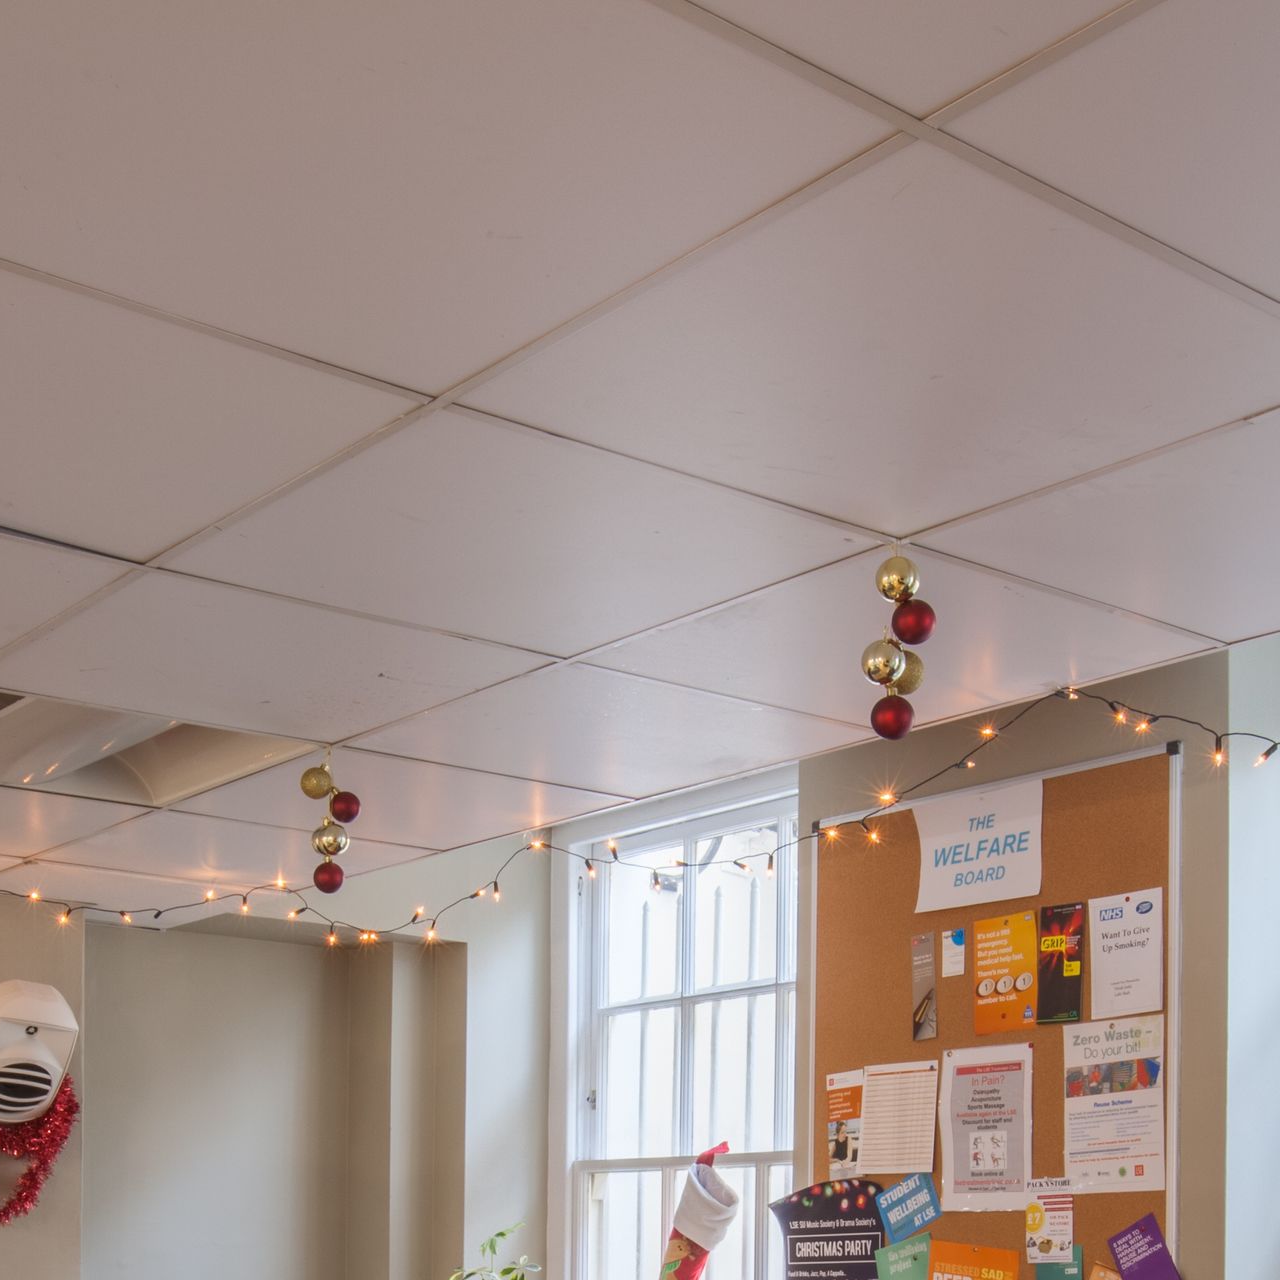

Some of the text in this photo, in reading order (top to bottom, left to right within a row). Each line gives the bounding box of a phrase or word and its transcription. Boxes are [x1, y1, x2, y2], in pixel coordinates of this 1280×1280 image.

[969, 814, 996, 832] THE
[933, 831, 1031, 868] WELFARE
[953, 866, 1006, 887] BOARD
[1100, 908, 1123, 921] NHS
[1101, 926, 1151, 940] Want To Give
[1042, 937, 1065, 949] GRIP
[1102, 938, 1150, 954] Up Smoking?
[1072, 1035, 1100, 1047] Zero
[1104, 1028, 1142, 1041] Waste
[1084, 1041, 1141, 1059] Do your bit!
[971, 1074, 1005, 1087] In Pain?
[880, 1174, 920, 1208] STUDENT
[887, 1188, 931, 1224] WELLBEING
[807, 1220, 819, 1228] Music
[820, 1219, 835, 1230] Society
[840, 1219, 855, 1227] Drama
[913, 1206, 936, 1227] AT LSE
[796, 1240, 872, 1258] CHRISTMAS PARTY
[935, 1262, 980, 1277] STRESSED
[981, 1267, 1004, 1280] SAD
